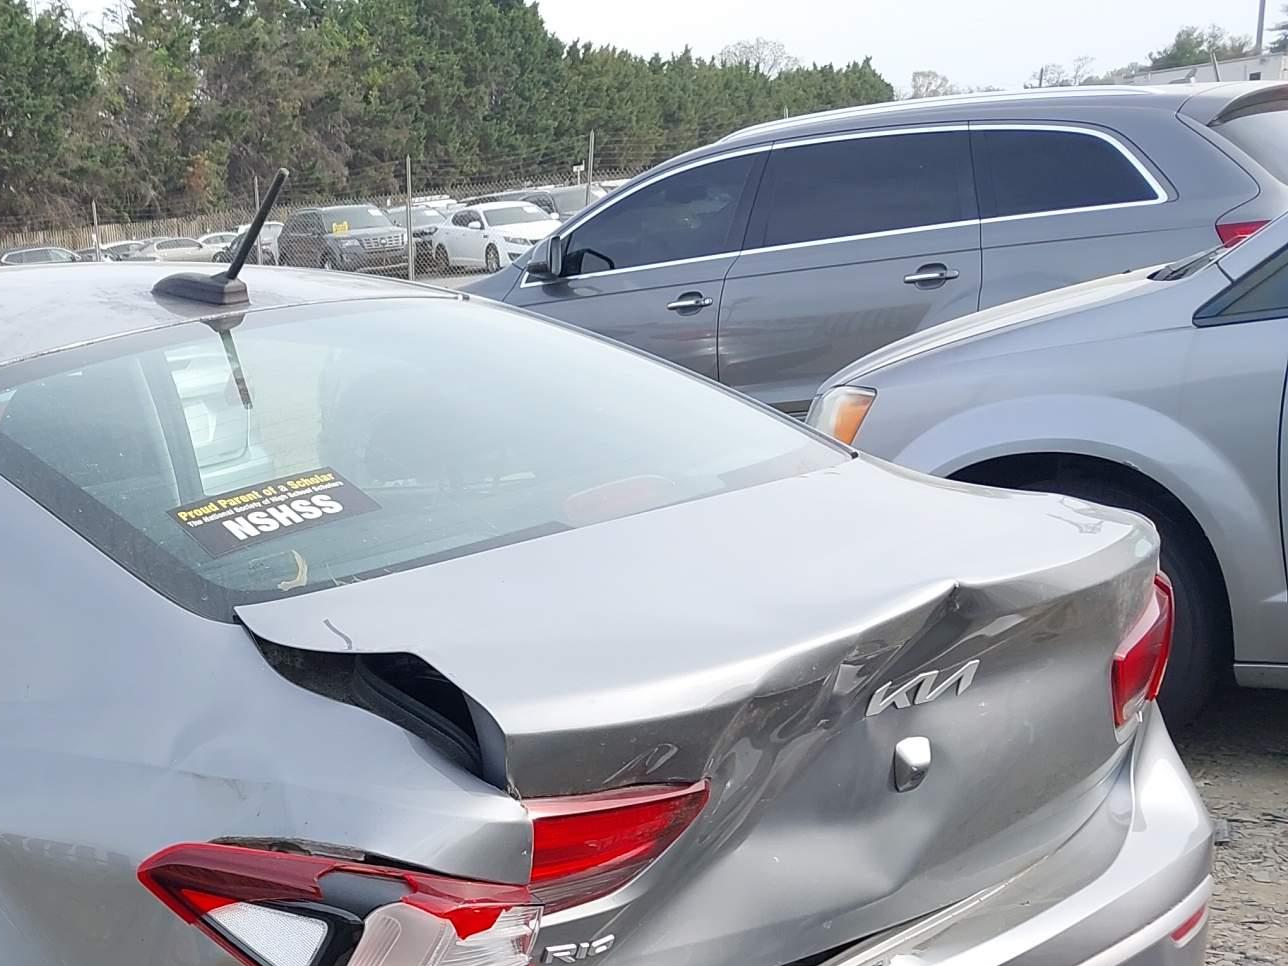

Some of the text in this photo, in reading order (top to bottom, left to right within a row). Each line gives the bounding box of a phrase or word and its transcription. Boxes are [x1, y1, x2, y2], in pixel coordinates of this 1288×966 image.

[177, 472, 335, 521] Proud Parent of a Scholar
[186, 519, 204, 528] The
[202, 508, 235, 523] National
[233, 501, 262, 513] Society
[287, 487, 313, 498] School
[222, 494, 344, 541] NSHSS
[865, 659, 980, 717] KIA
[545, 934, 615, 964] RIO
